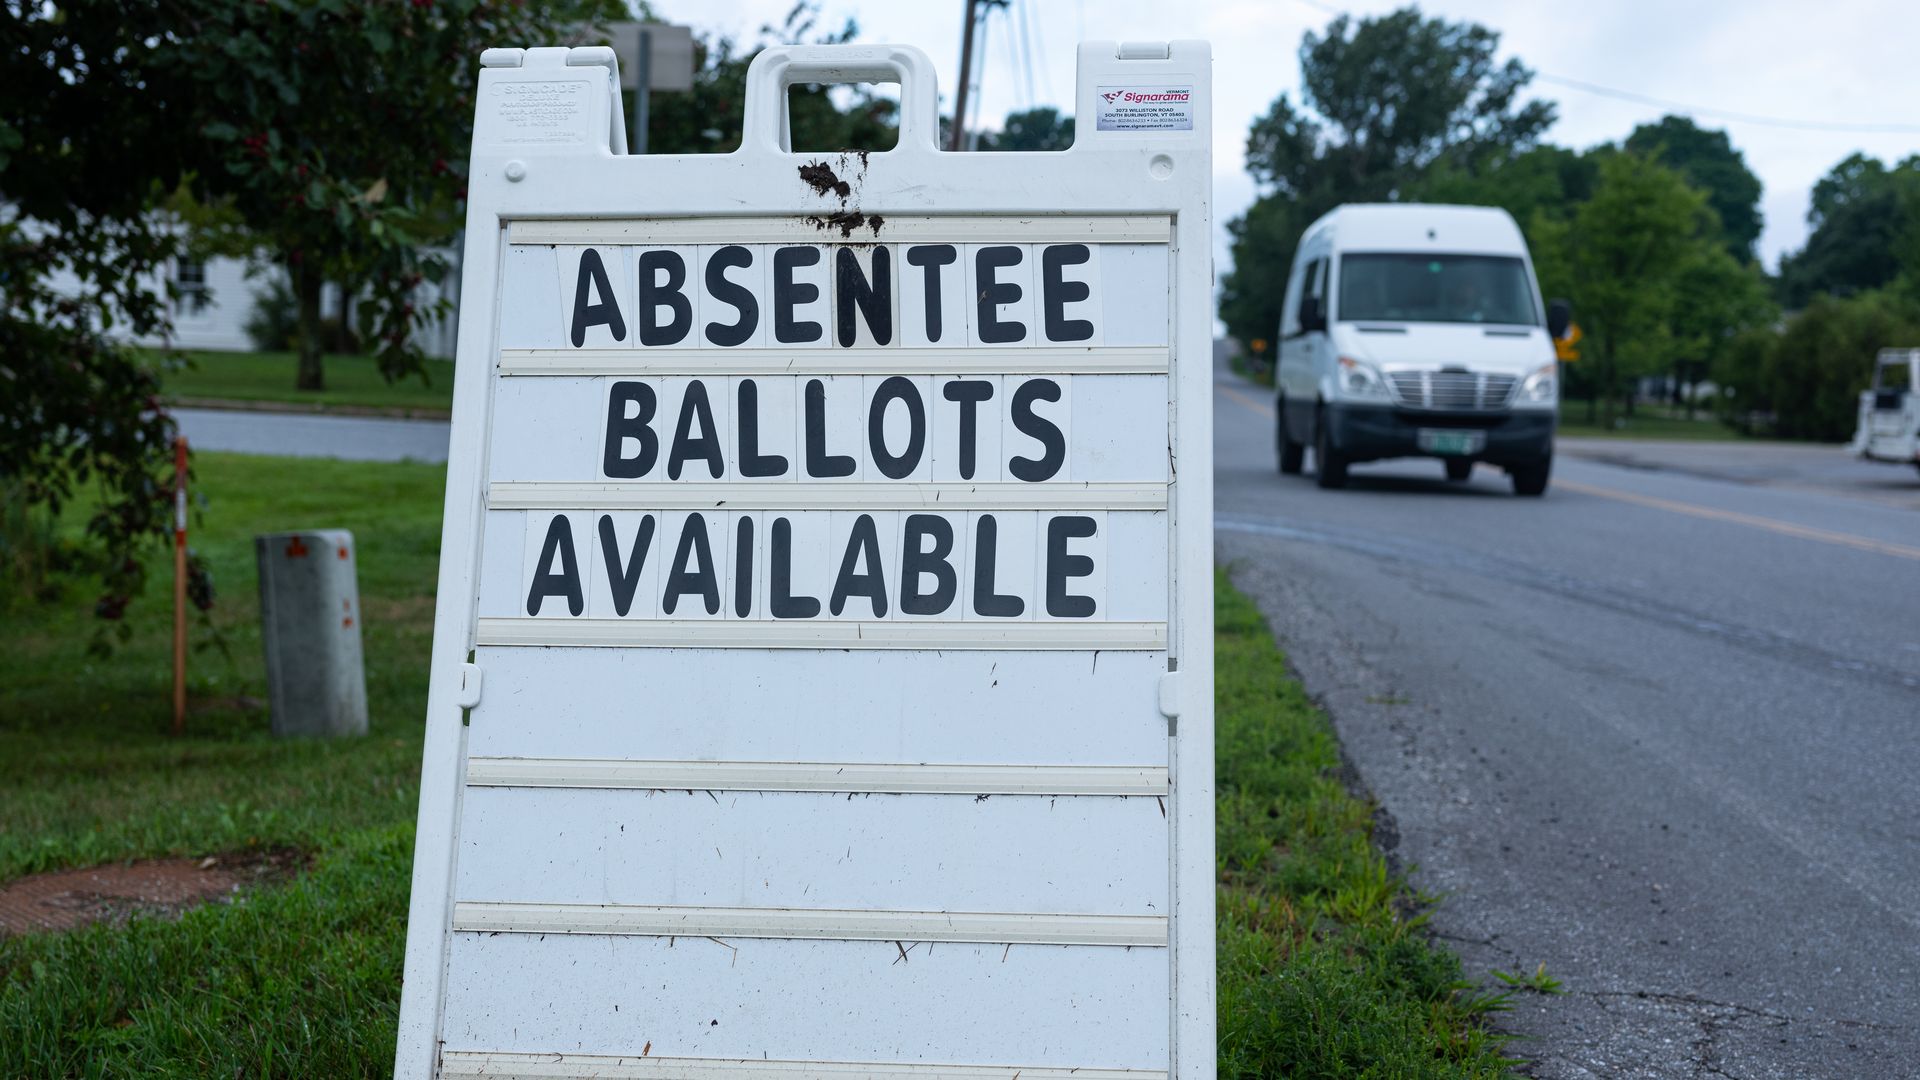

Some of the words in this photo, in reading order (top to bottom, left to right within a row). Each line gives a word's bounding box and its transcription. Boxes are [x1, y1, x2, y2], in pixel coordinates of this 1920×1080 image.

[1124, 92, 1189, 103] Signarama
[570, 243, 1095, 348] ABSENTEE
[603, 375, 1066, 483] BALLOTS
[526, 512, 1097, 619] AVAILABLE
